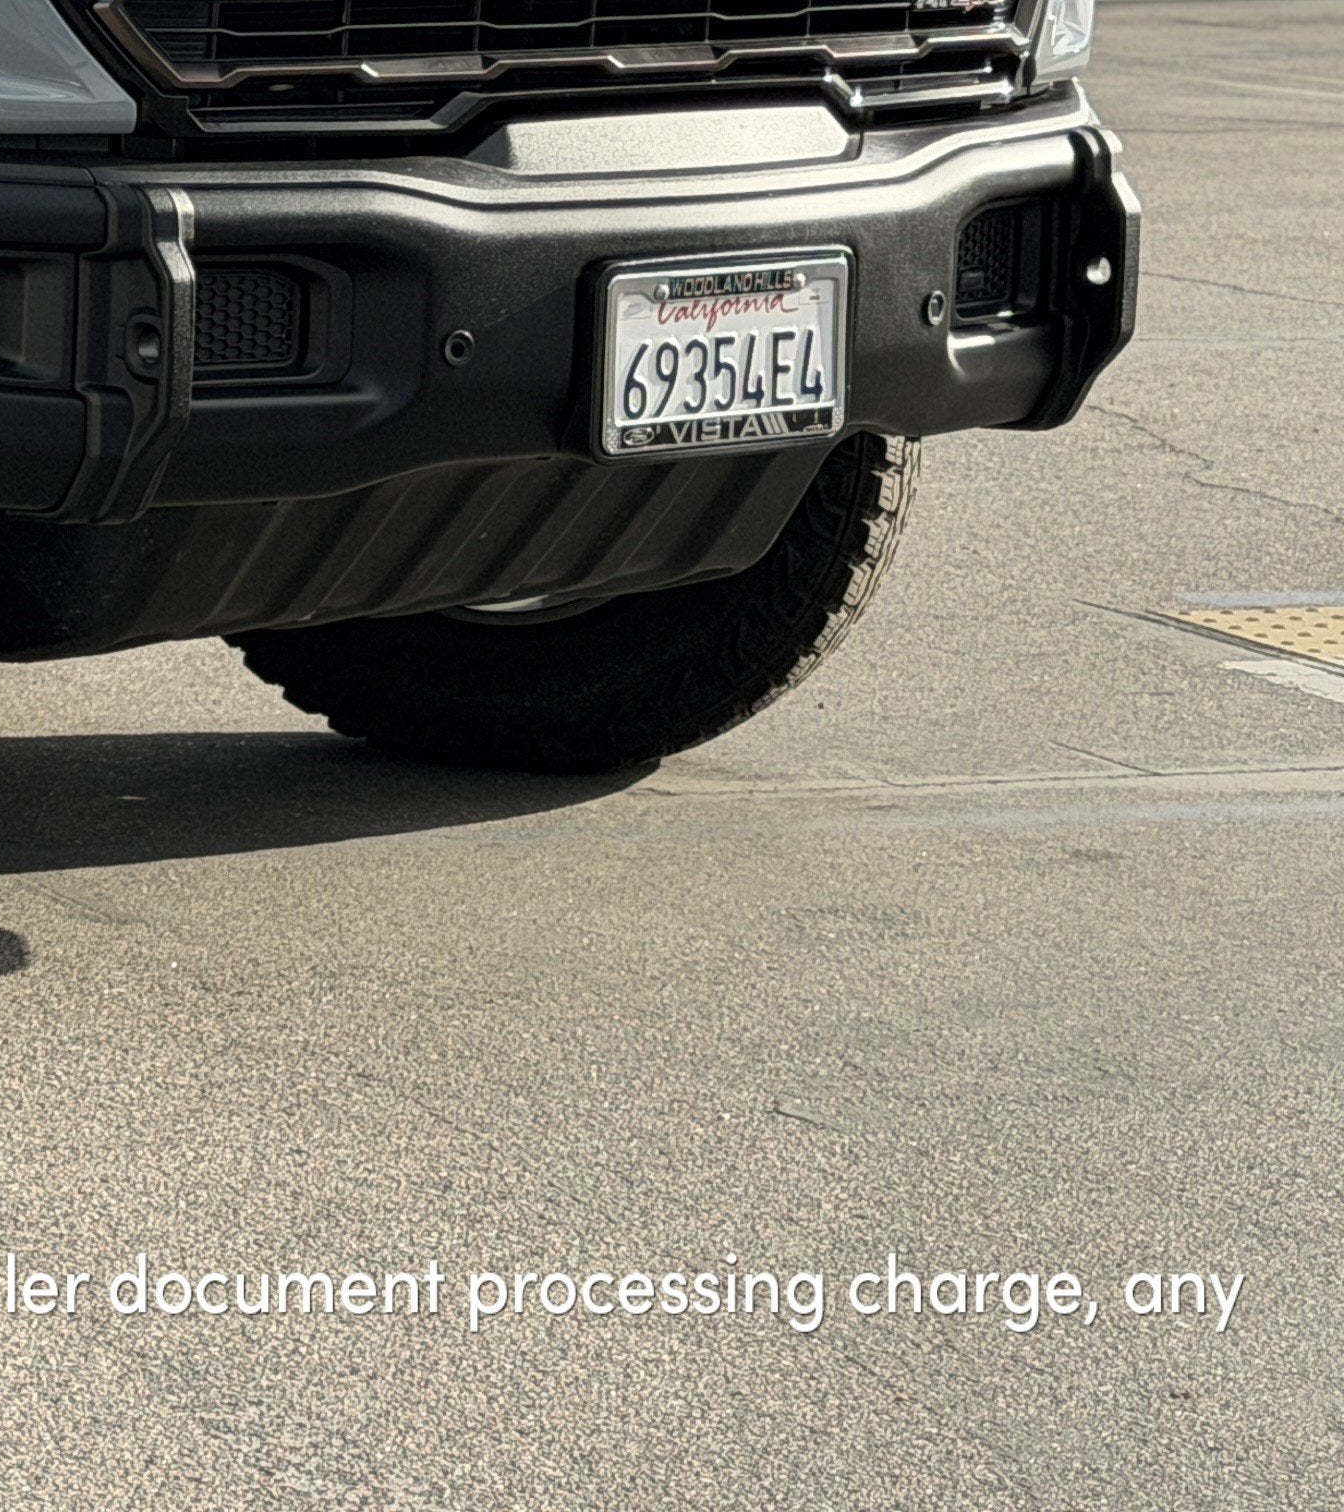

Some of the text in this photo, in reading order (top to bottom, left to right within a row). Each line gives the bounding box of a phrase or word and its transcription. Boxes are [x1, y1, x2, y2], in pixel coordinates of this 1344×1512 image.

[671, 269, 793, 297] WOODLAND HILLS
[657, 292, 800, 332] California
[623, 329, 825, 419] 69354E4
[669, 414, 763, 444] VISTA
